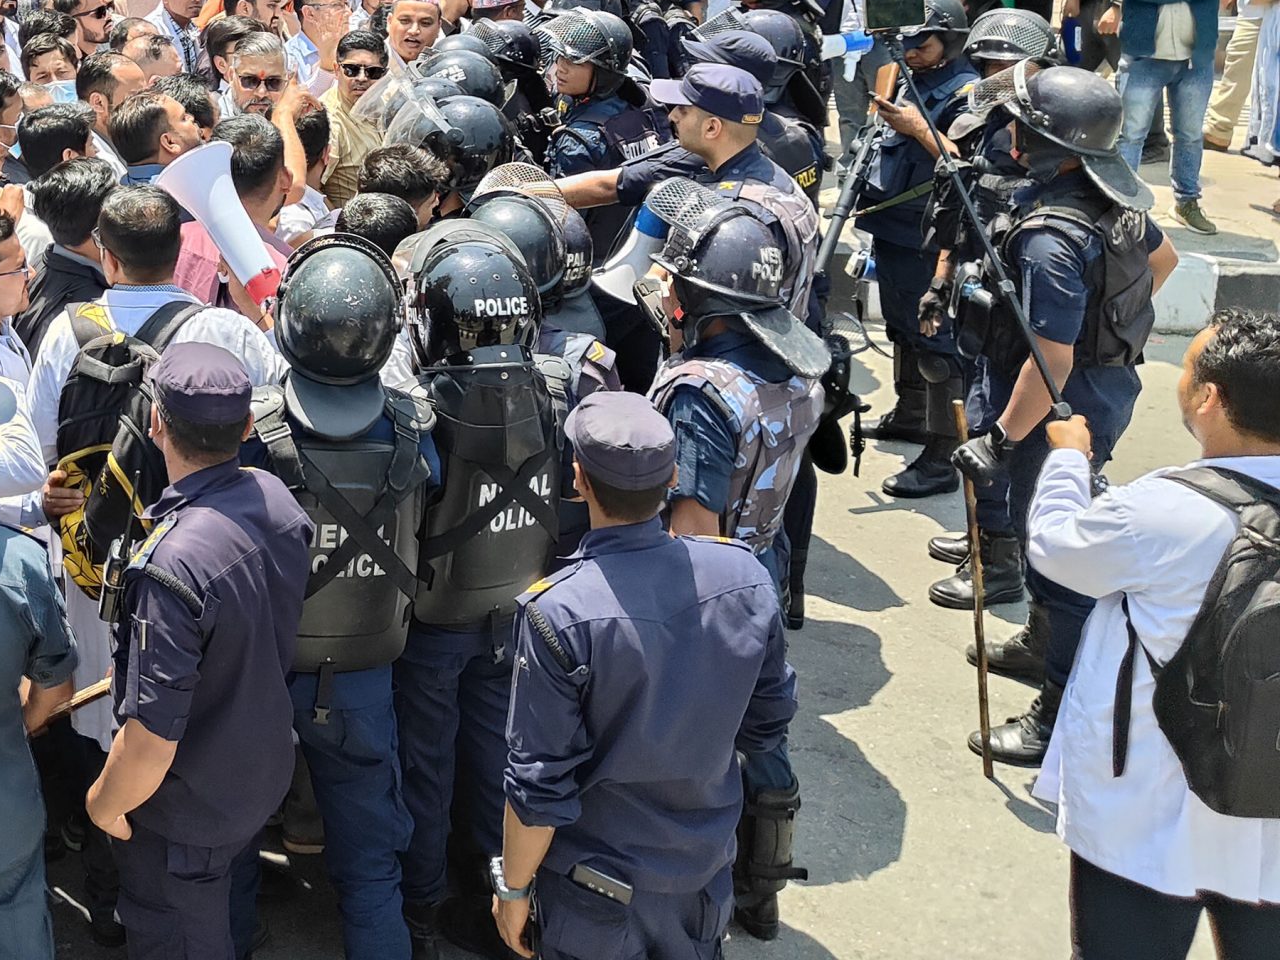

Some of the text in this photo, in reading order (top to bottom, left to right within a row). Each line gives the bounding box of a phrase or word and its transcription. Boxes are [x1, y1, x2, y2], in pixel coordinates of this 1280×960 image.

[566, 252, 586, 268] PAL
[474, 296, 528, 317] POLICE
[478, 473, 551, 507] NAL
